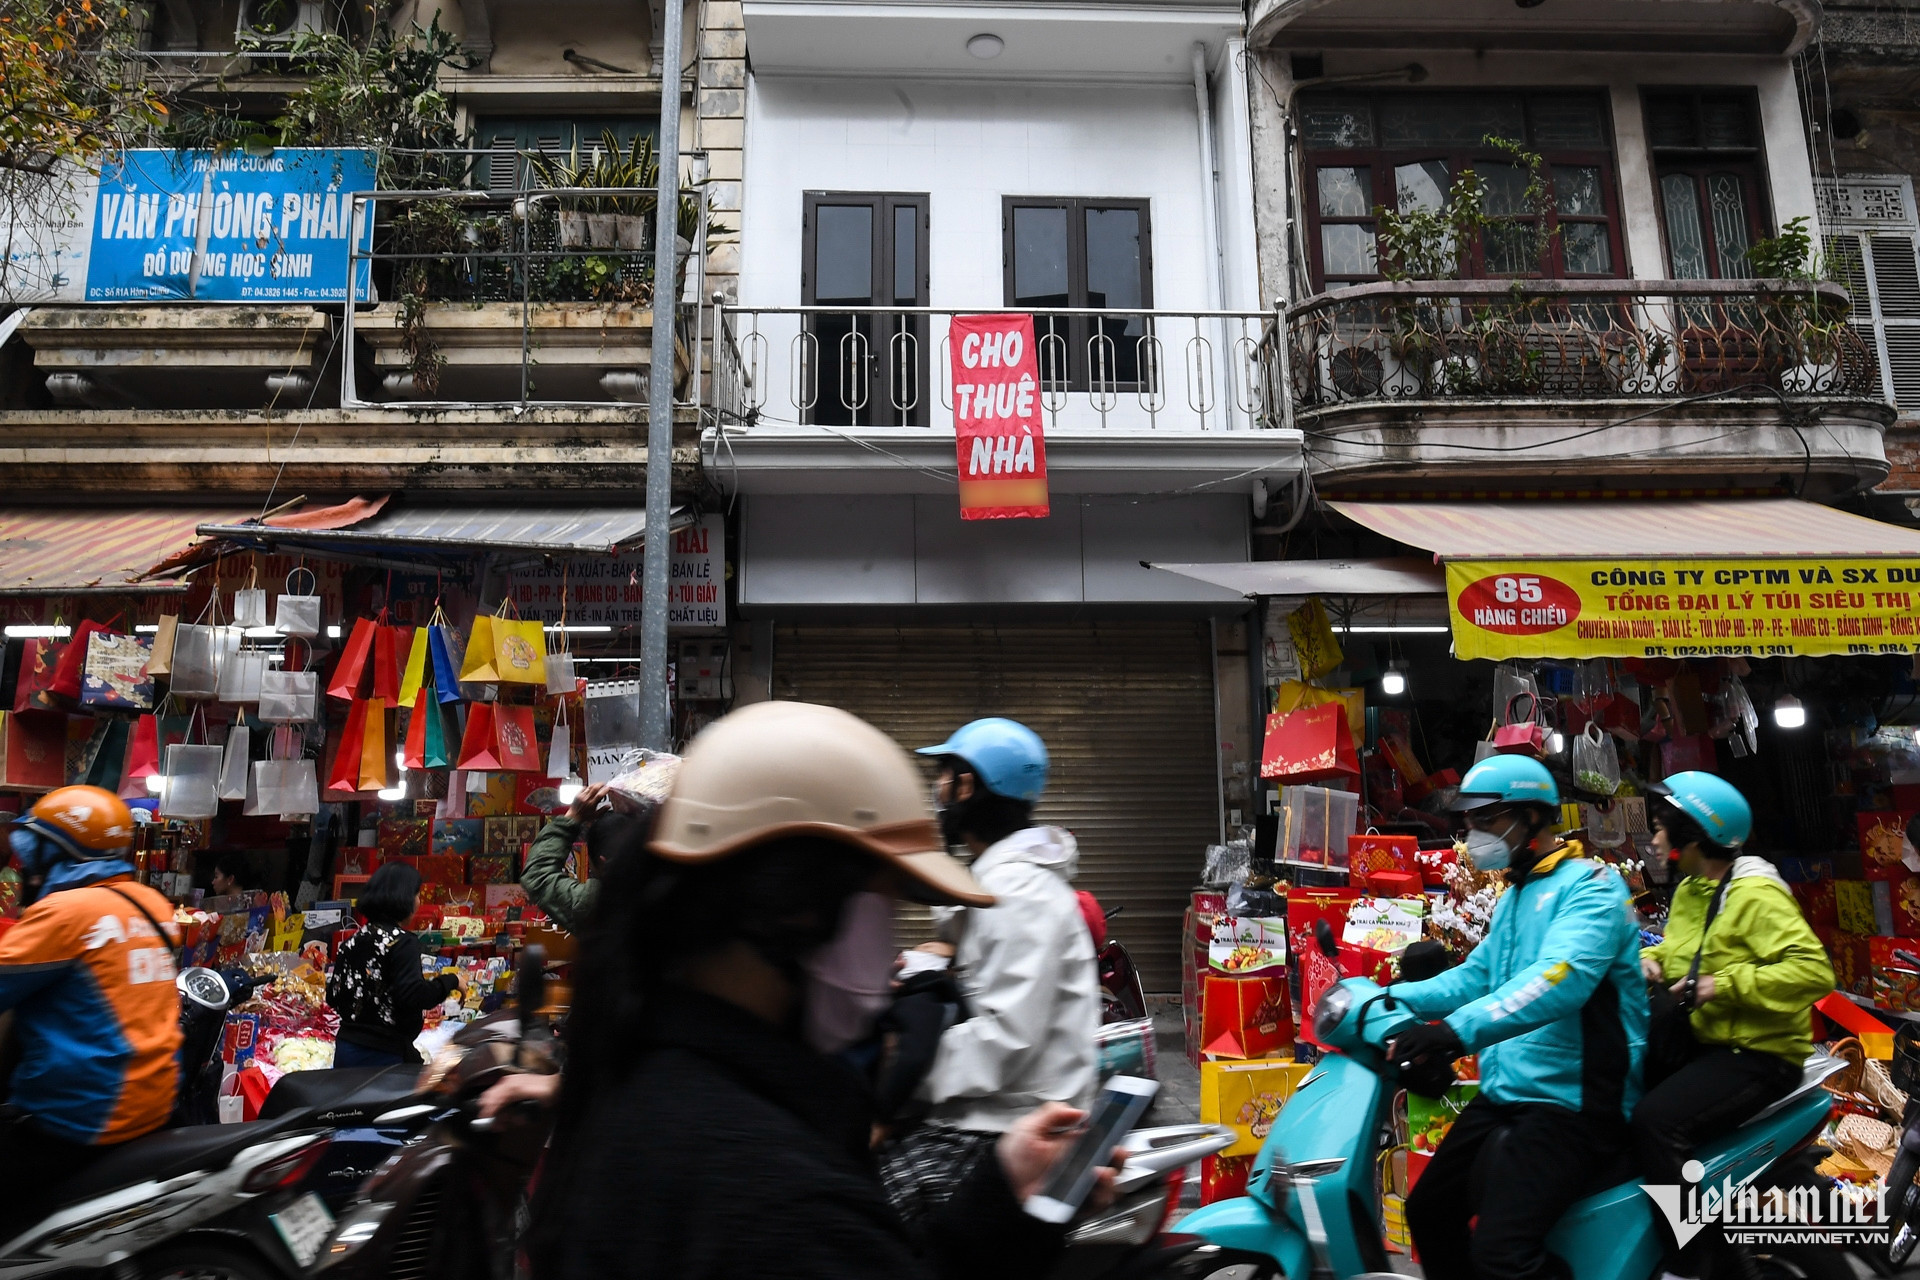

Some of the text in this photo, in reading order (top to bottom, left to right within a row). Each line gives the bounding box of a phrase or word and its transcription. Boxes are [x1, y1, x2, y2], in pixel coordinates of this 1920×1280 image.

[101, 183, 160, 239] VĂN
[164, 181, 273, 239] PHÒNG
[143, 244, 167, 277] ĐỒ
[230, 252, 266, 283] HỌC
[271, 253, 313, 278] SINH
[90, 287, 103, 297] ĐC:
[241, 287, 253, 297] ĐT:
[254, 287, 281, 297] 04.3826
[282, 287, 299, 297] 1445
[304, 288, 319, 297] Fax:
[961, 330, 1024, 369] CHO
[955, 372, 1036, 420] THUÊ
[968, 425, 1035, 475] NHÀ
[672, 560, 694, 578] BÁN
[697, 559, 711, 578] LẺ
[1591, 568, 1666, 586] CÔNG
[1674, 570, 1705, 585] TY
[1714, 569, 1790, 585] CPTM
[1798, 566, 1834, 584] VÀ
[1842, 568, 1879, 584] SX
[520, 584, 532, 603] HD
[538, 584, 551, 603] PP
[605, 584, 618, 603] CO
[680, 581, 694, 603] TÚI
[696, 579, 717, 603] GIẤY
[1495, 577, 1543, 603] 85
[1604, 588, 1911, 614] TỔNG ĐẠI LÝ TÚI SIÊU THỊ
[520, 605, 540, 622] VẤN
[575, 605, 587, 622] KẾ
[605, 605, 618, 622] ẤN
[669, 606, 695, 622] CHẤT
[697, 607, 718, 624] LIỆU
[1474, 603, 1567, 626] HÀNG CHIẾU
[1577, 616, 1611, 639] CHUYÊN
[1612, 616, 1630, 639] BÁN
[1632, 616, 1656, 639] BUÔN
[1663, 616, 1680, 639] BÁN
[1682, 613, 1693, 639] LẺ
[1733, 618, 1746, 638] HD
[1752, 618, 1764, 637] PP
[1771, 618, 1784, 637] PE
[1790, 613, 1817, 637] MÀNG
[1818, 618, 1830, 637] CO
[1837, 613, 1861, 637] BĂNG
[1862, 613, 1884, 637] DÍNH
[1889, 612, 1914, 636] BĂNG
[1644, 646, 1668, 657] ĐT:
[1672, 645, 1753, 657] (024)3828
[1757, 645, 1795, 655] 1301
